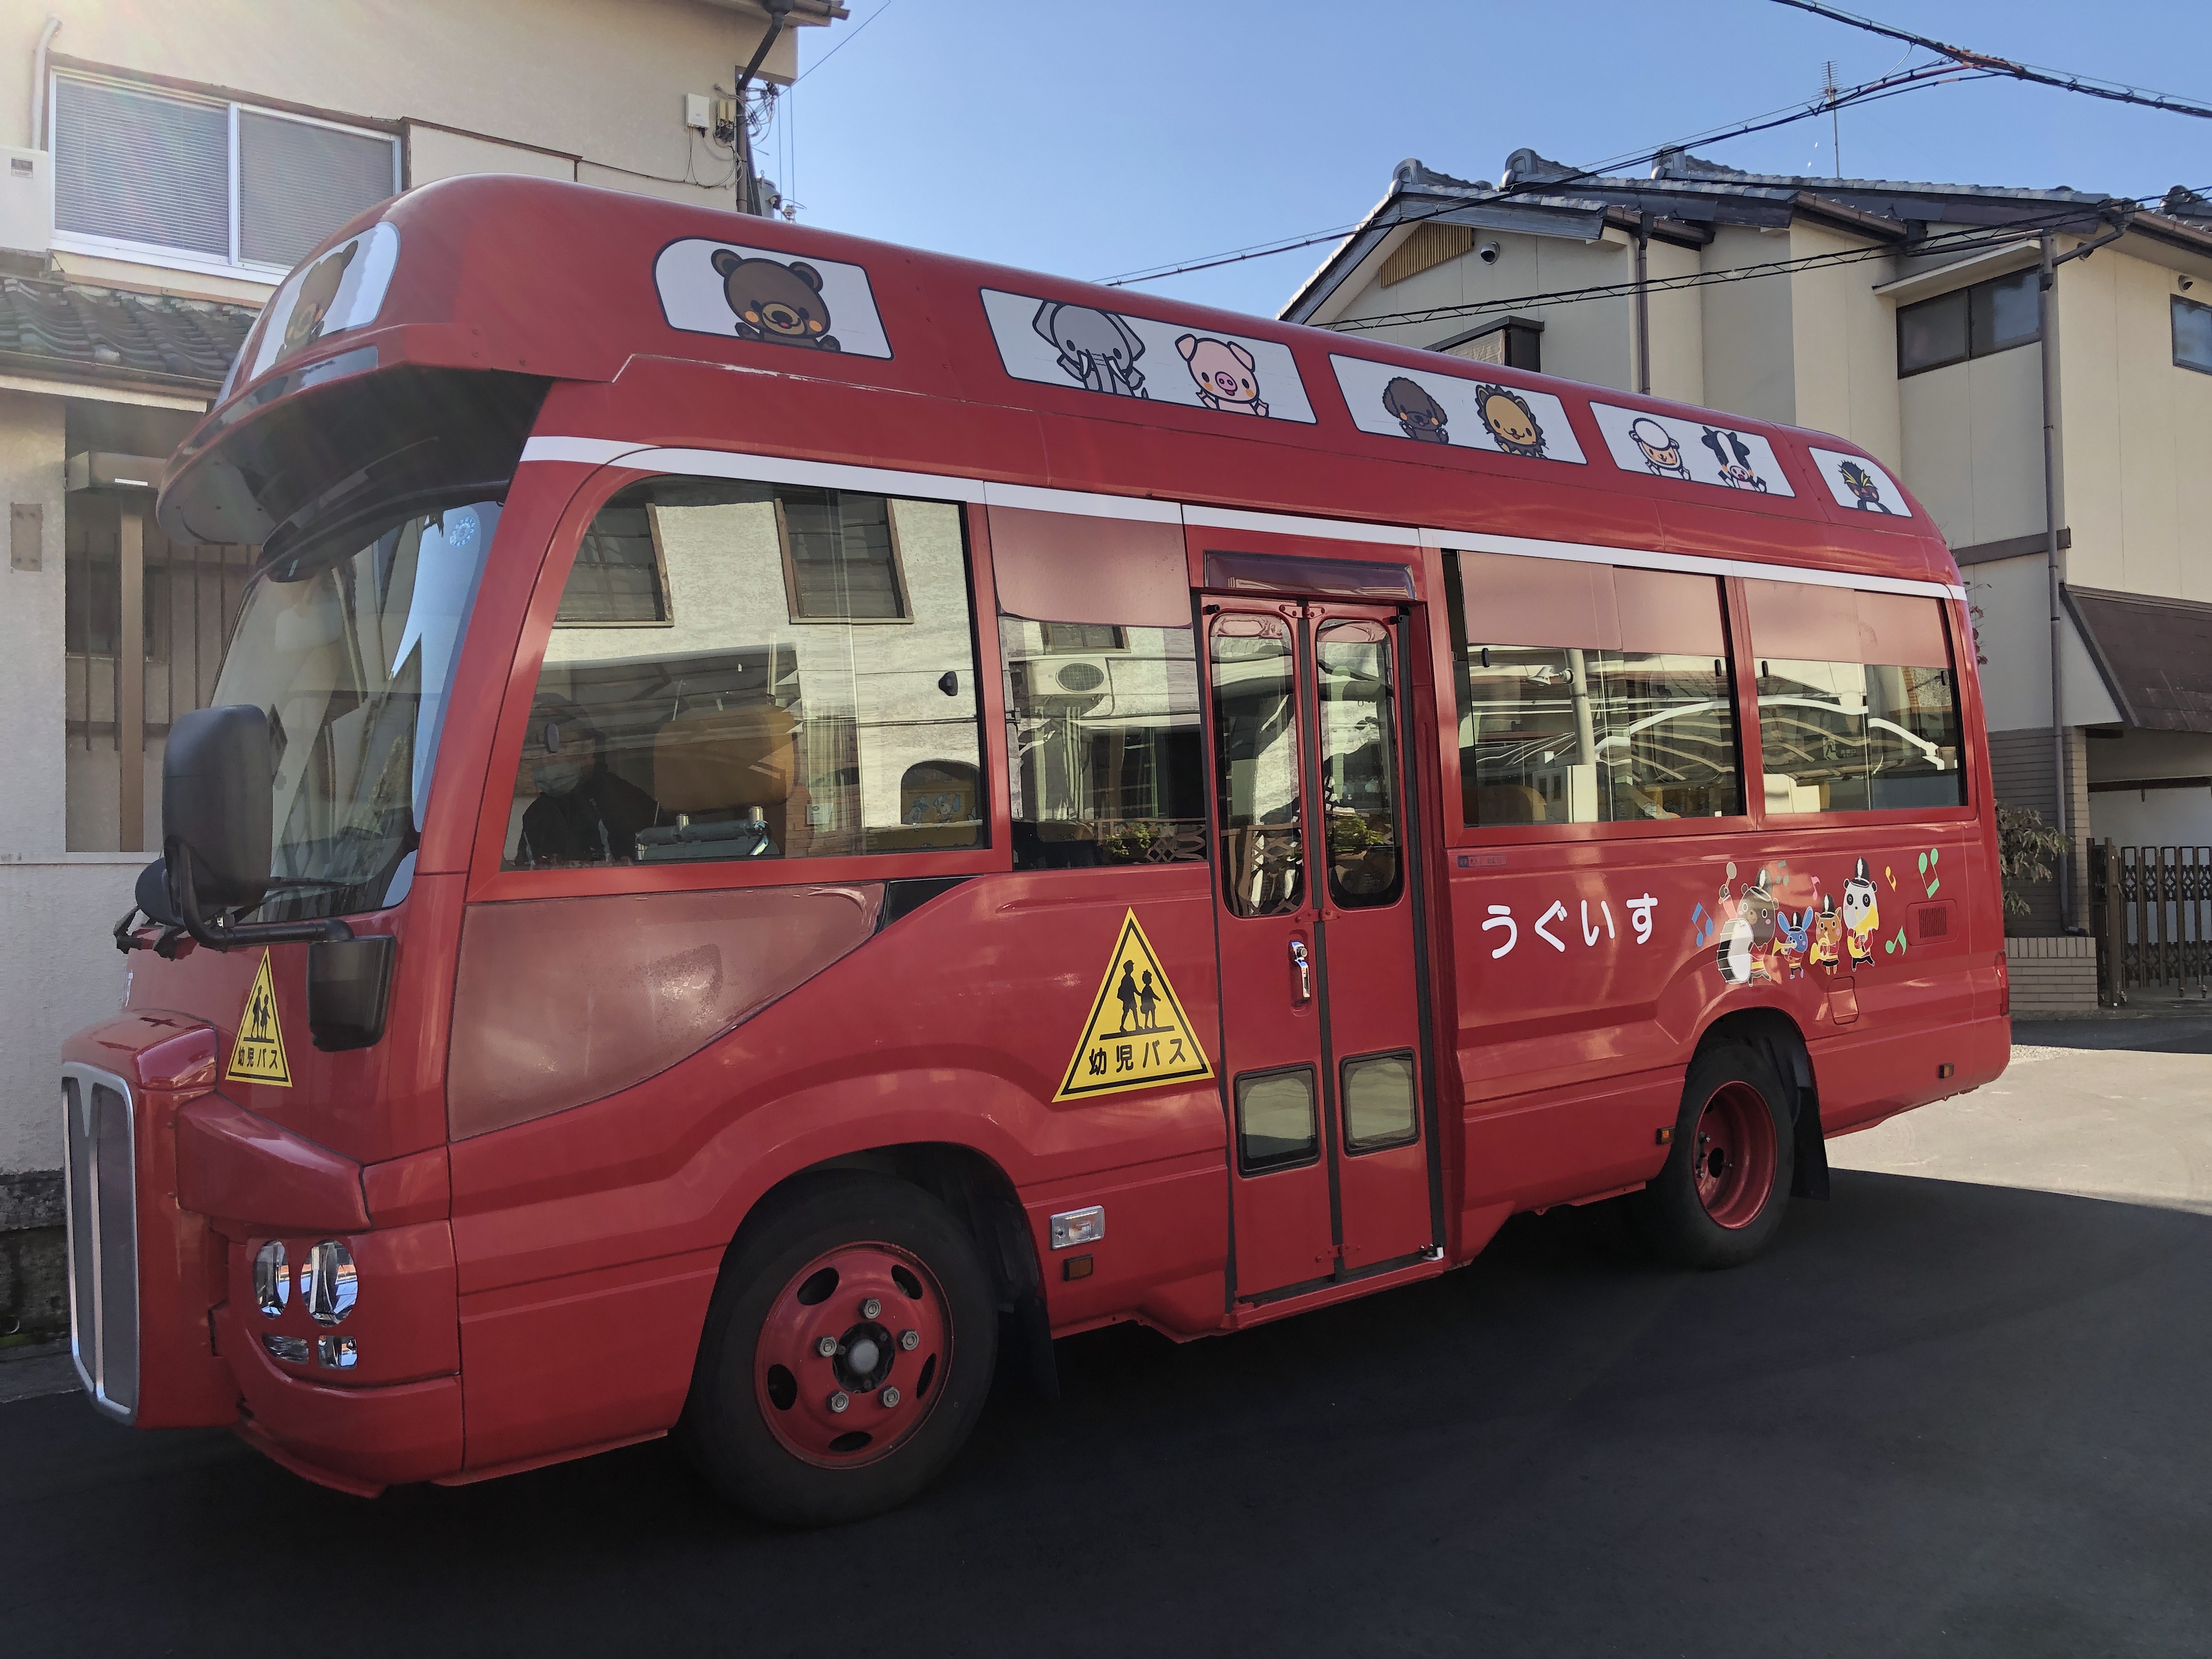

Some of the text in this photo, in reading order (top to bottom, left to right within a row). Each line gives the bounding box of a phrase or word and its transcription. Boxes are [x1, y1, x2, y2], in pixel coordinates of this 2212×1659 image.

[1482, 893, 1658, 959] うぐいす
[238, 1046, 278, 1070] 幼児バス
[1089, 1039, 1186, 1075] 幼児バス
